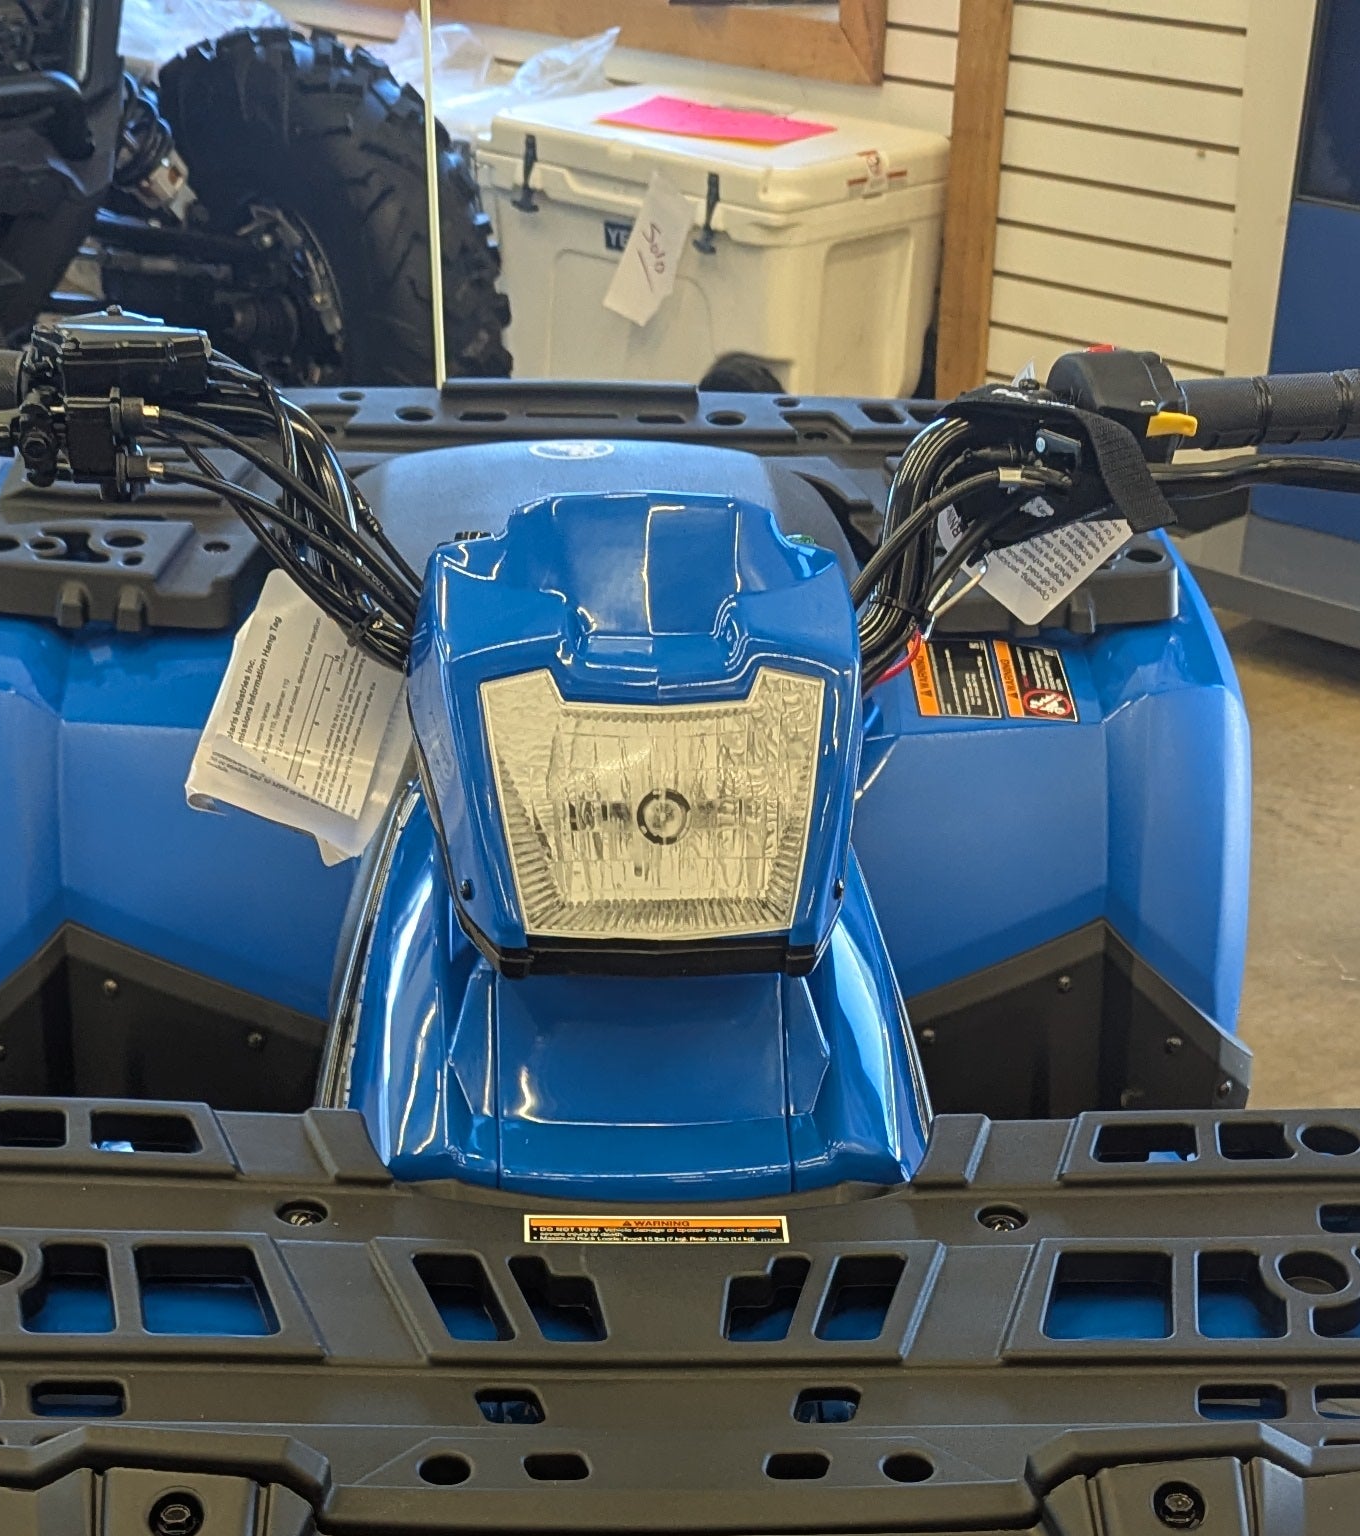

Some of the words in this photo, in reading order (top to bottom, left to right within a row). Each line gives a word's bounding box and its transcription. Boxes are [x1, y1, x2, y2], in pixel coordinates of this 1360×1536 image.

[227, 716, 238, 739] laris
[233, 675, 250, 715] Industries
[244, 659, 256, 674] Inc.
[238, 706, 253, 742] missions
[247, 658, 266, 705] Information
[261, 633, 276, 657] Hang
[269, 616, 282, 631] Tag
